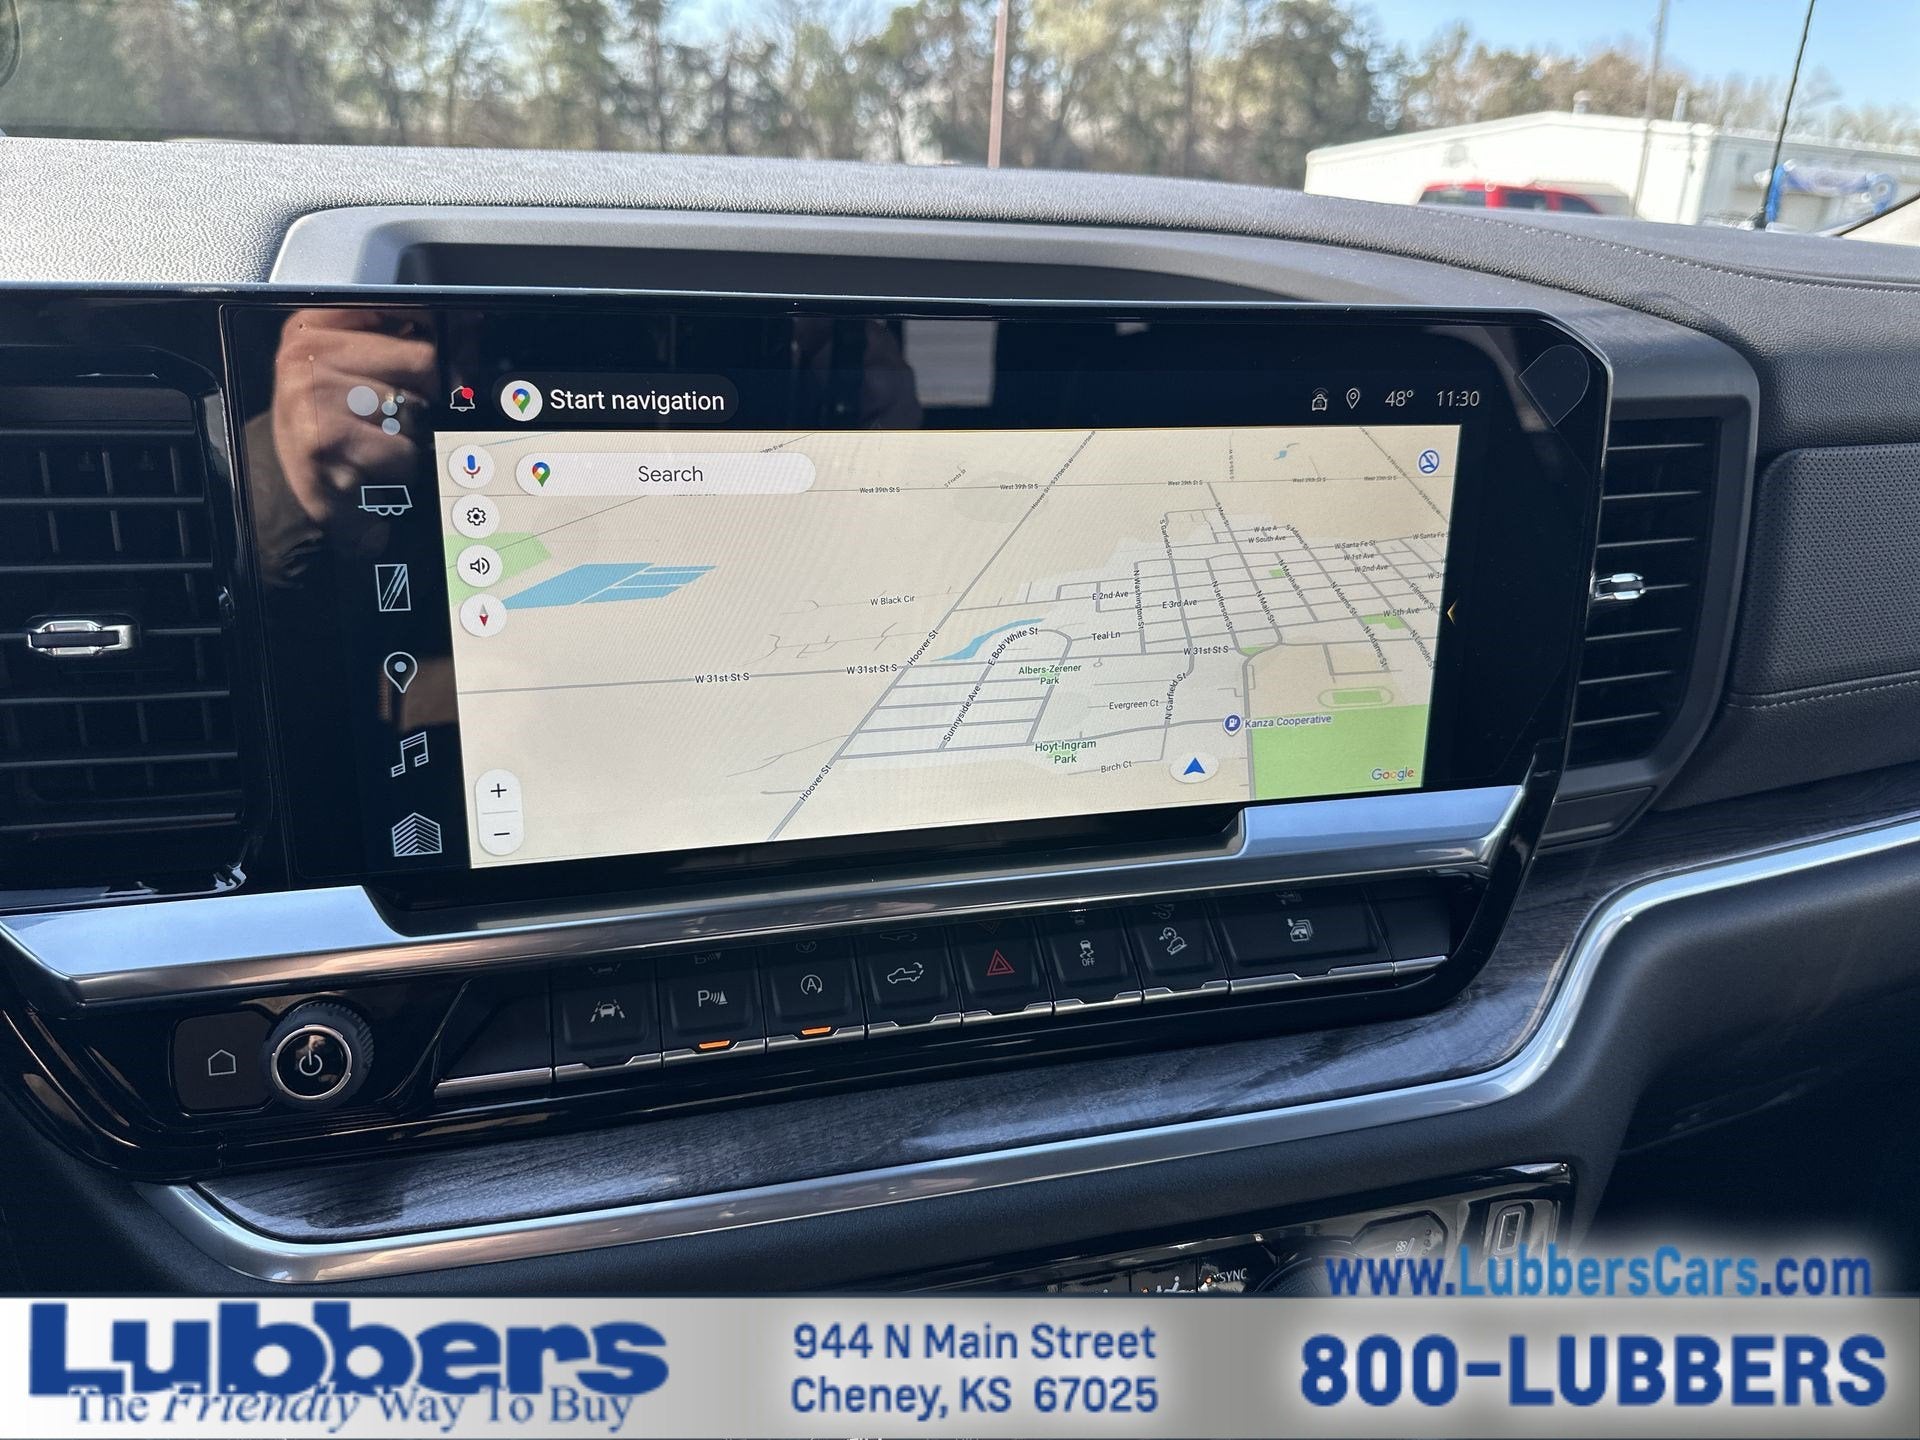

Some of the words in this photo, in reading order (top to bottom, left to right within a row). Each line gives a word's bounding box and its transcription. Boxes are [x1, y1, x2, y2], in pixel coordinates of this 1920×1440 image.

[550, 389, 605, 411] Start
[611, 390, 725, 415] navigation
[1436, 390, 1480, 407] 11:30
[638, 465, 704, 483] Search
[1248, 536, 1255, 544] W
[1256, 535, 1273, 543] South
[1361, 552, 1374, 560] Ave
[1278, 559, 1285, 567] N
[1362, 565, 1375, 573] 2nd
[1211, 580, 1219, 588] N
[1281, 565, 1301, 592] Marshall
[1092, 593, 1098, 601] E
[1099, 592, 1113, 600] 2nd
[1114, 591, 1129, 599] Ave
[1135, 578, 1144, 621] Washington
[1255, 590, 1263, 598] N
[1296, 589, 1304, 599] St
[1330, 581, 1337, 589] N
[1335, 587, 1351, 610] Adams
[1348, 606, 1358, 617] St
[1409, 582, 1430, 607] Filmore
[1427, 602, 1435, 611] St
[870, 598, 879, 606] W
[880, 596, 902, 605] Black
[903, 595, 915, 603] Cir
[1162, 601, 1168, 609] E
[1168, 600, 1182, 608] 3rd
[1182, 599, 1198, 607] Ave
[1214, 587, 1231, 622] Jefferson
[1258, 597, 1271, 616] Main
[1383, 609, 1391, 617] W
[1392, 608, 1404, 617] 5th
[1404, 607, 1420, 615] Ave
[1267, 613, 1275, 624] St
[1138, 620, 1145, 630] St
[1226, 621, 1233, 630] St
[1028, 627, 1039, 636] St
[1091, 632, 1109, 641] Teal
[1110, 631, 1121, 640] Ln
[1410, 630, 1417, 638] N
[1004, 630, 1028, 646] White
[907, 637, 932, 666] Hoover
[928, 629, 939, 641] St
[991, 641, 1007, 659] Bob
[1183, 647, 1192, 656] W
[1193, 646, 1212, 655] 31st
[1213, 646, 1222, 654] St
[1222, 645, 1229, 653] S
[1363, 626, 1371, 635] N
[1367, 634, 1383, 657] Adams
[1379, 655, 1388, 667] St
[1412, 636, 1432, 663] Lincoln
[988, 658, 996, 667] E
[846, 667, 857, 675] W
[857, 665, 877, 675] 31st
[879, 664, 889, 673] St
[891, 664, 898, 672] S
[1018, 664, 1082, 675] Albers-Zerener
[695, 675, 705, 683] W
[707, 674, 728, 683] 31st
[731, 673, 741, 682] St
[742, 672, 750, 681] S
[1040, 676, 1060, 685] Park
[1166, 679, 1178, 712] Garfield
[1176, 672, 1187, 684] St
[1108, 700, 1148, 710] Evergreen
[1149, 699, 1159, 708] Ct
[943, 701, 972, 742] Sunnyside
[967, 685, 981, 702] Ave
[1244, 718, 1274, 728] Kanza
[1276, 714, 1332, 729] Cooperative
[1034, 740, 1097, 753] Hoyt-Ingram
[1054, 754, 1077, 764] Park
[1100, 762, 1121, 773] Birch
[1122, 760, 1132, 769] Ct
[1371, 766, 1415, 782] Google
[799, 772, 824, 802] Hoover
[821, 763, 832, 776] St
[1081, 957, 1096, 967] OFF
